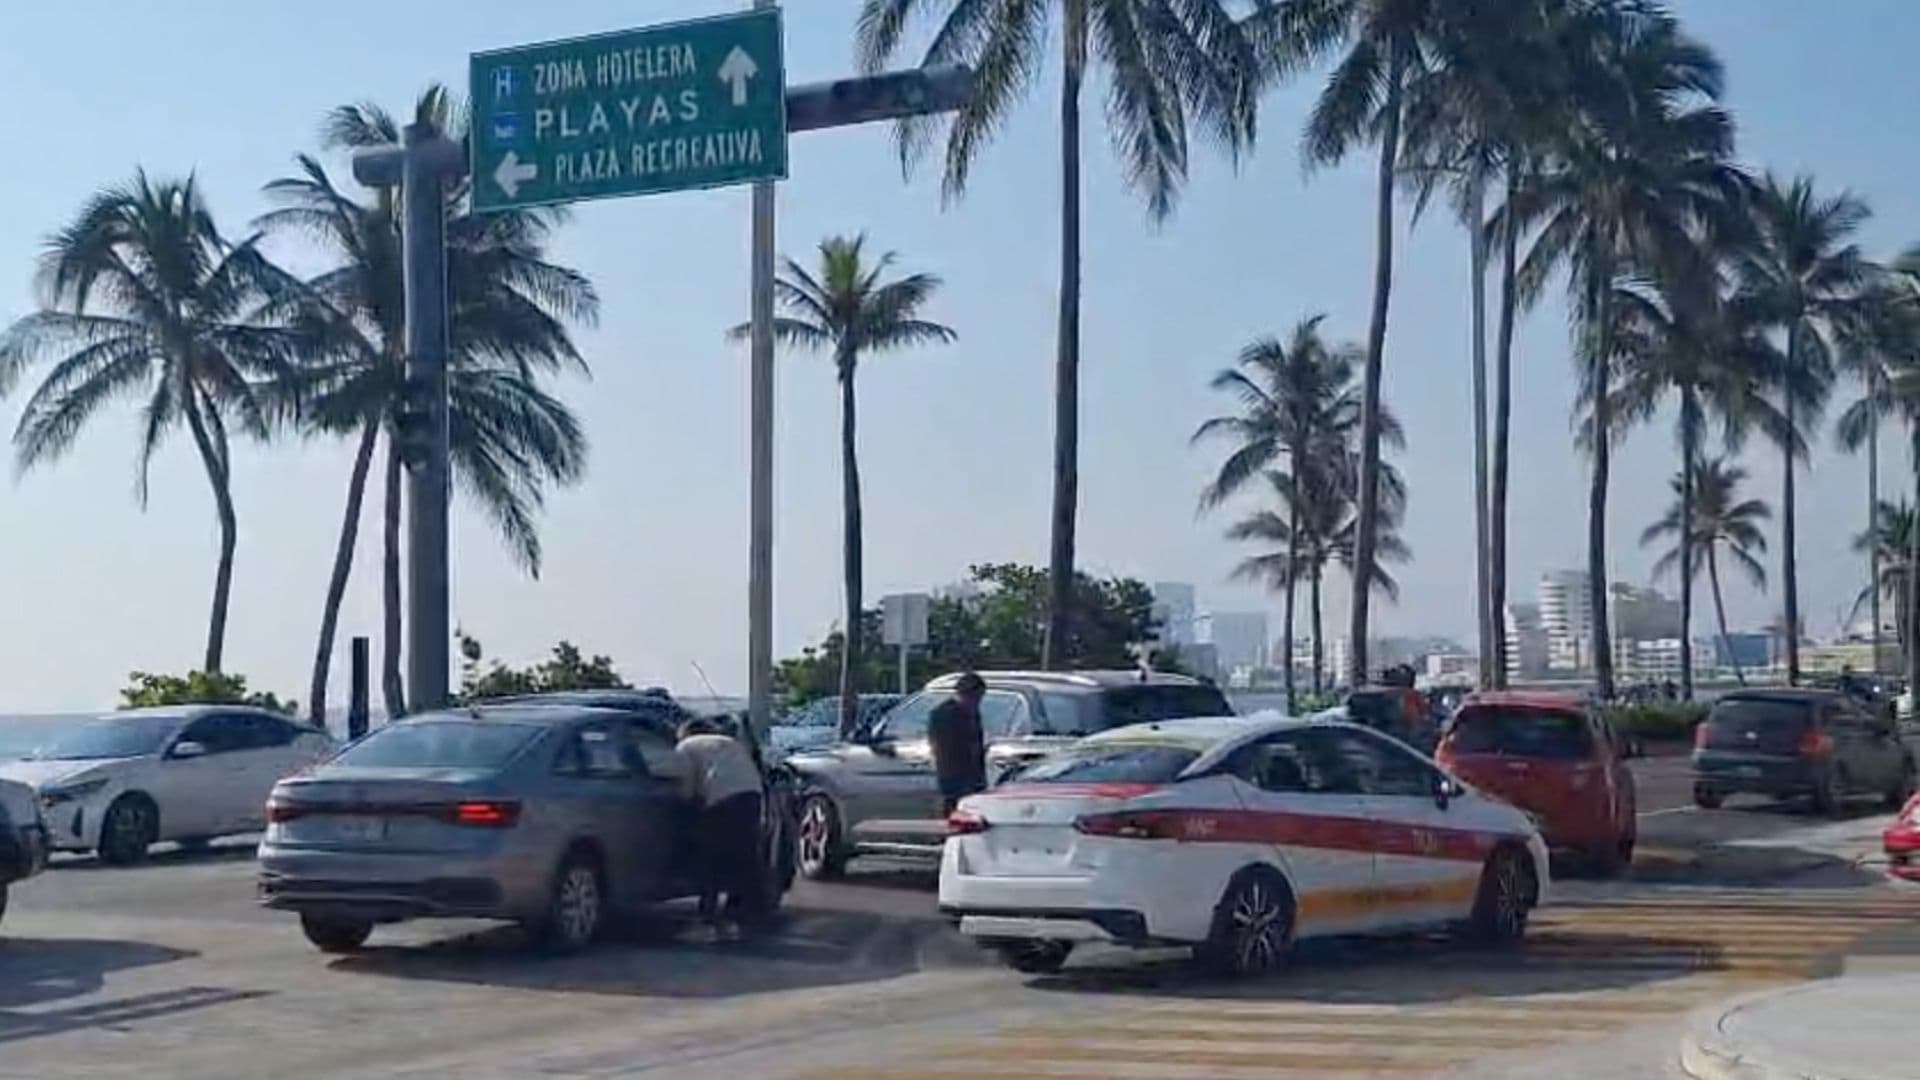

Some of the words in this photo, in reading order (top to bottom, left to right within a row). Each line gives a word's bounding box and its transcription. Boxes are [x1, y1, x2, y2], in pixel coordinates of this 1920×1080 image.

[535, 59, 586, 95] ZONA
[597, 43, 696, 87] HOTELERA
[535, 90, 699, 139] PLAYAS
[555, 149, 620, 184] PLAZA
[632, 128, 762, 175] RECREATIVA
